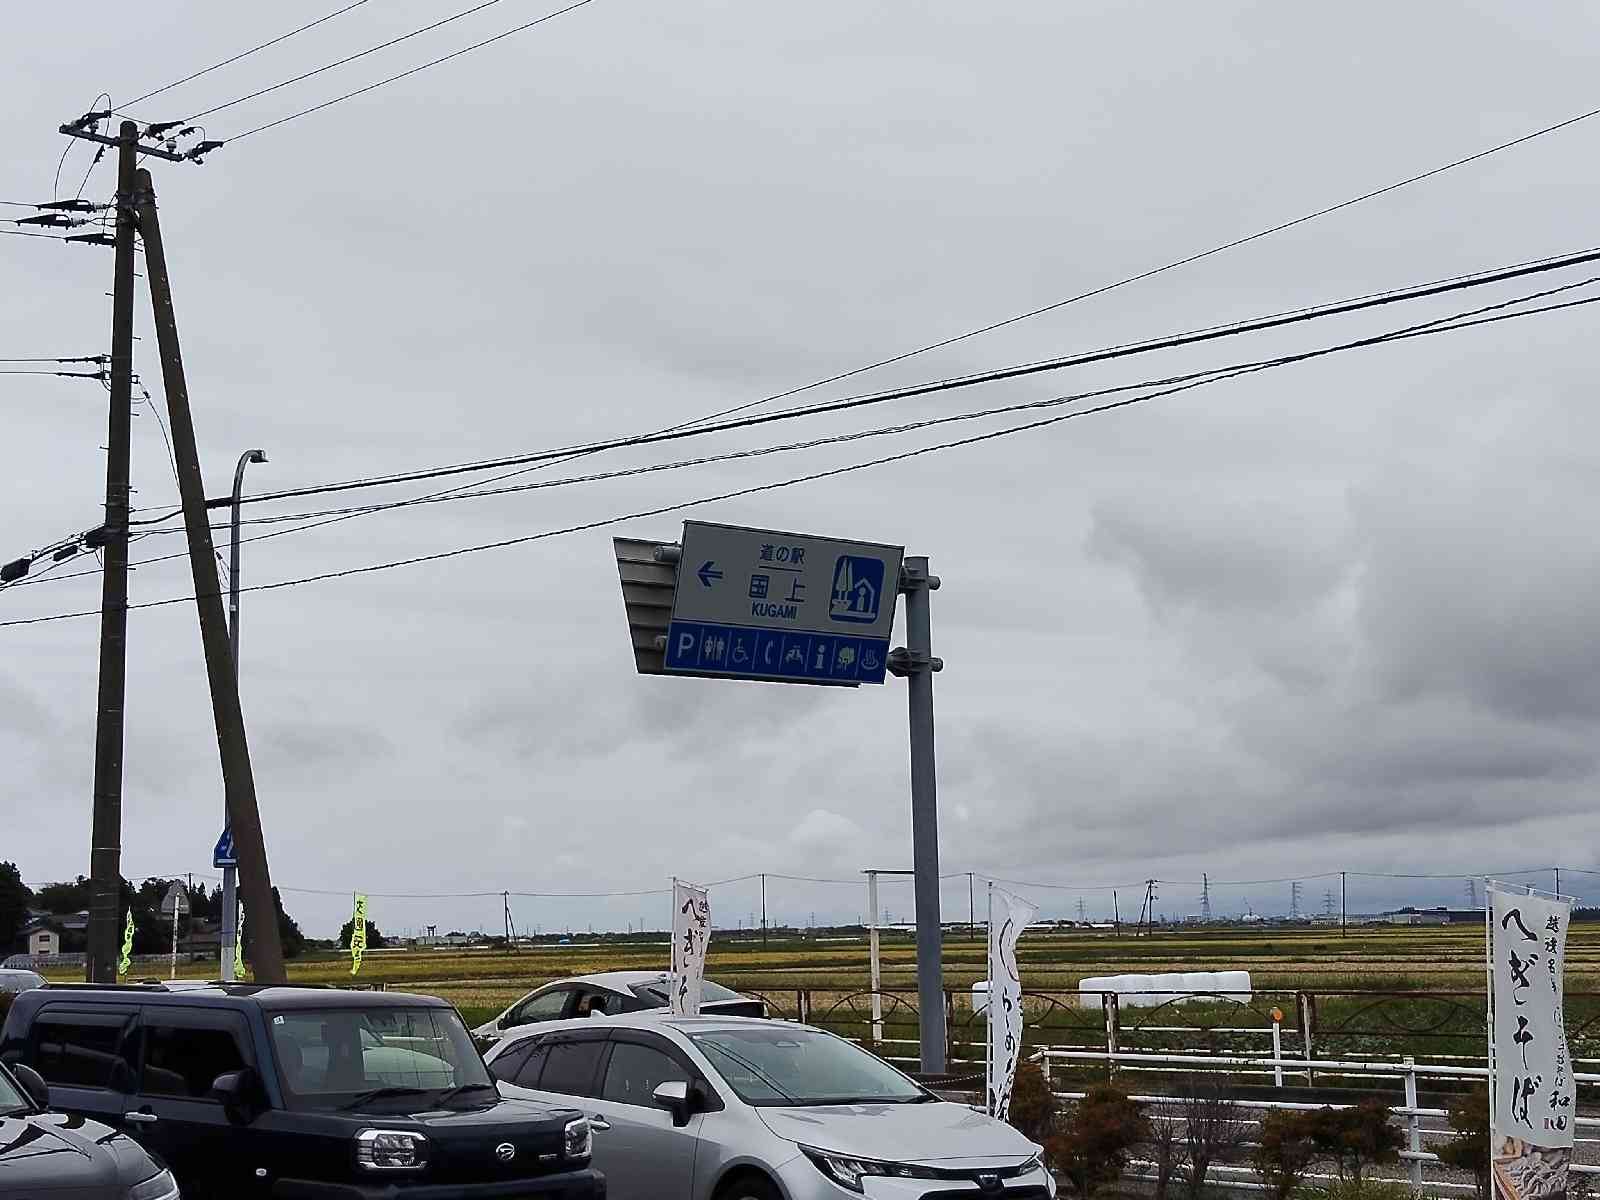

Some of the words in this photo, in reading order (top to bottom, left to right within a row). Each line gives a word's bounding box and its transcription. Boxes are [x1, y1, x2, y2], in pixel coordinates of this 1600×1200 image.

[759, 543, 805, 564] 道の駅
[748, 574, 806, 603] 国上
[751, 601, 798, 620] KUGAMI
[677, 632, 694, 659] P
[1502, 908, 1542, 1129] へぎそば
